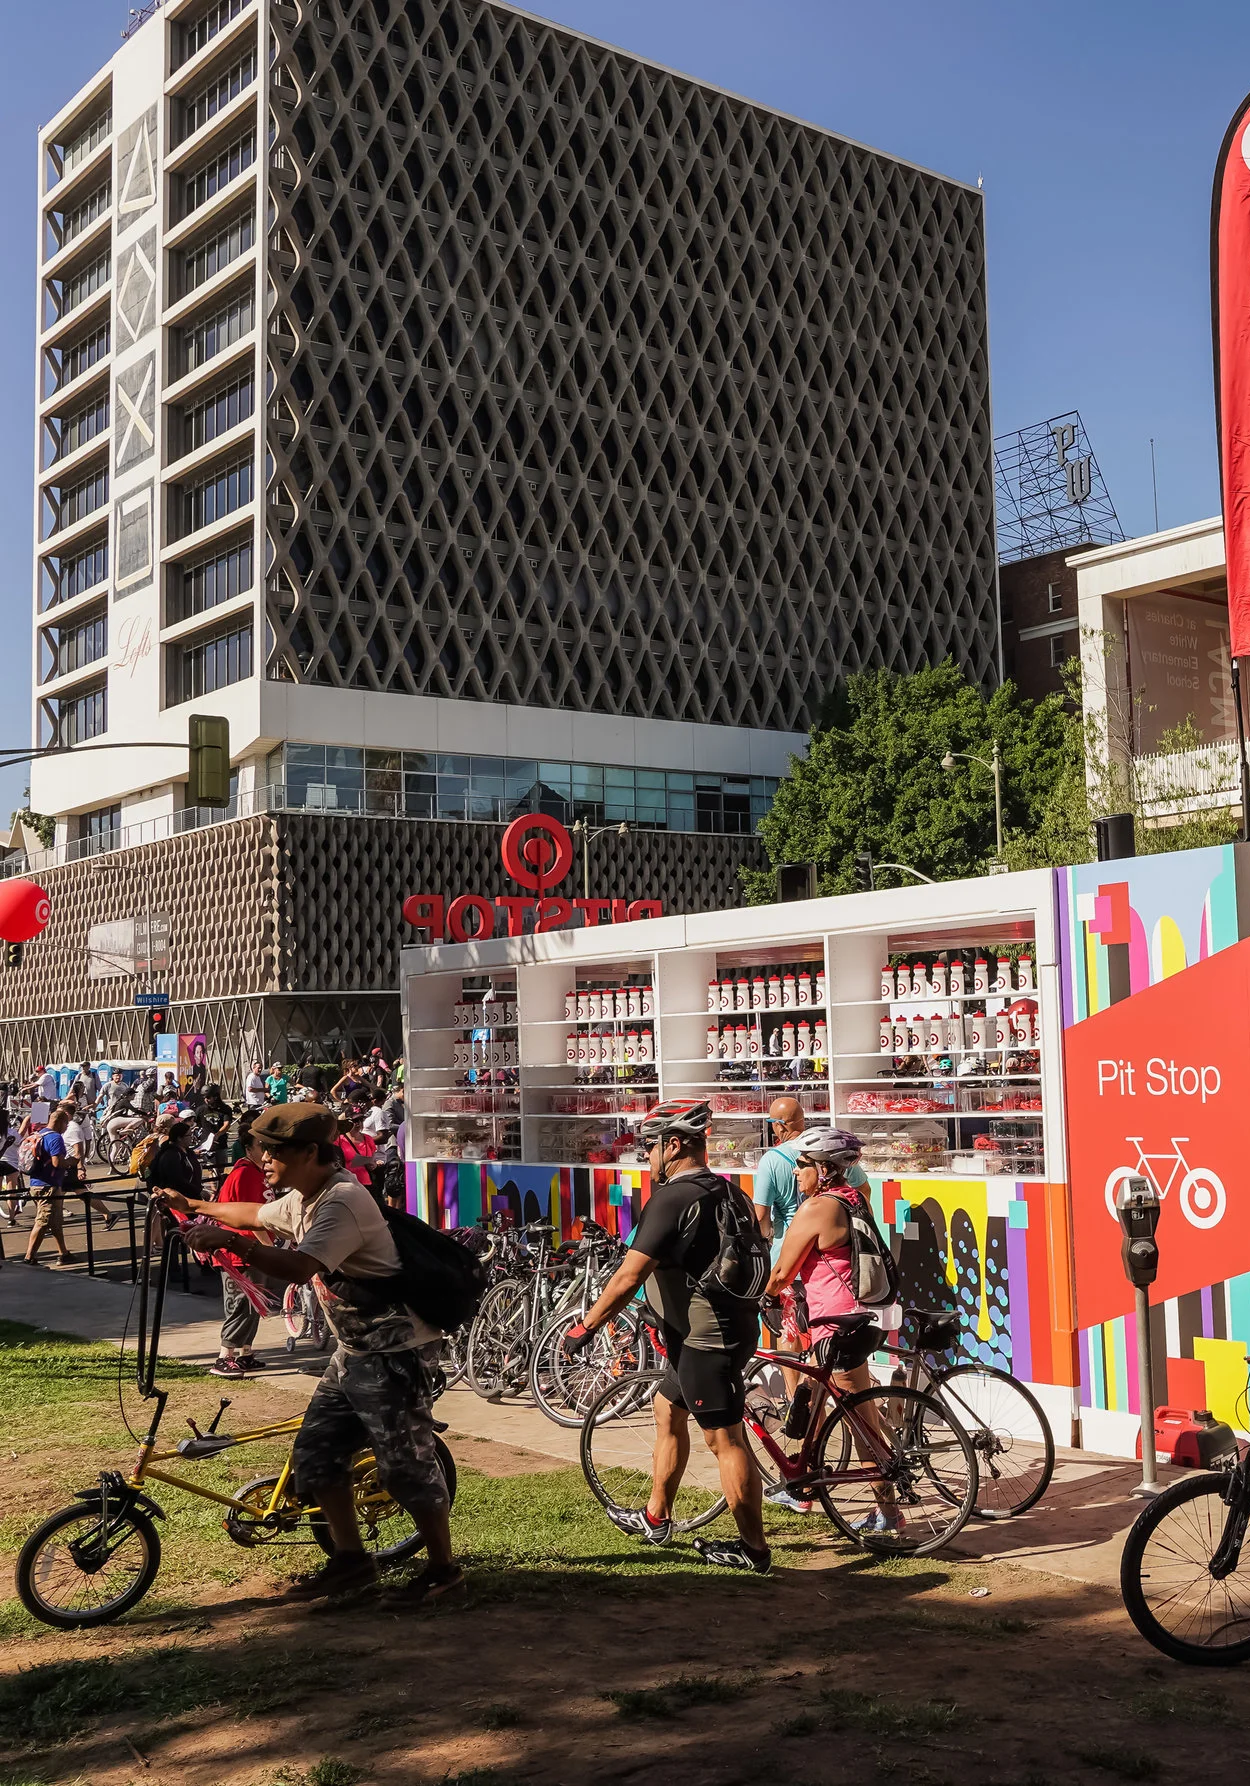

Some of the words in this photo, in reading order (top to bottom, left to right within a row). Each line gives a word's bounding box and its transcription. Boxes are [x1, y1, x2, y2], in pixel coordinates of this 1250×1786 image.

[136, 996, 168, 1004] Wilshire
[1097, 1059, 1136, 1096] Pit
[1146, 1058, 1221, 1104] Stop
